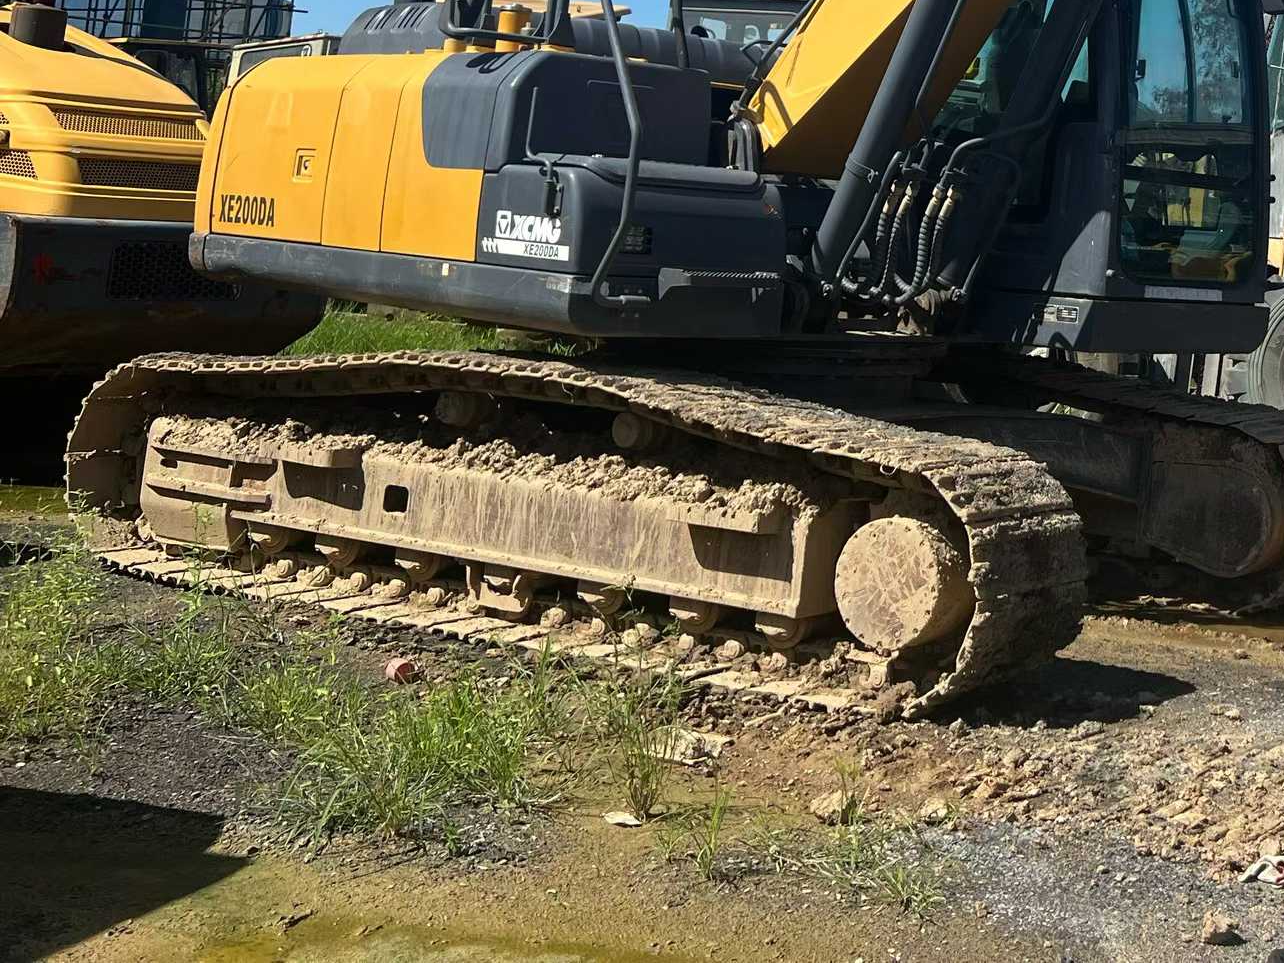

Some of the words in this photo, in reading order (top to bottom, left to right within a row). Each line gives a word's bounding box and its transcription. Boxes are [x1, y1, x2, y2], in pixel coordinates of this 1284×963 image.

[219, 194, 274, 227] XE200DA
[510, 214, 561, 243] XCMG
[523, 244, 559, 257] XE200DA
